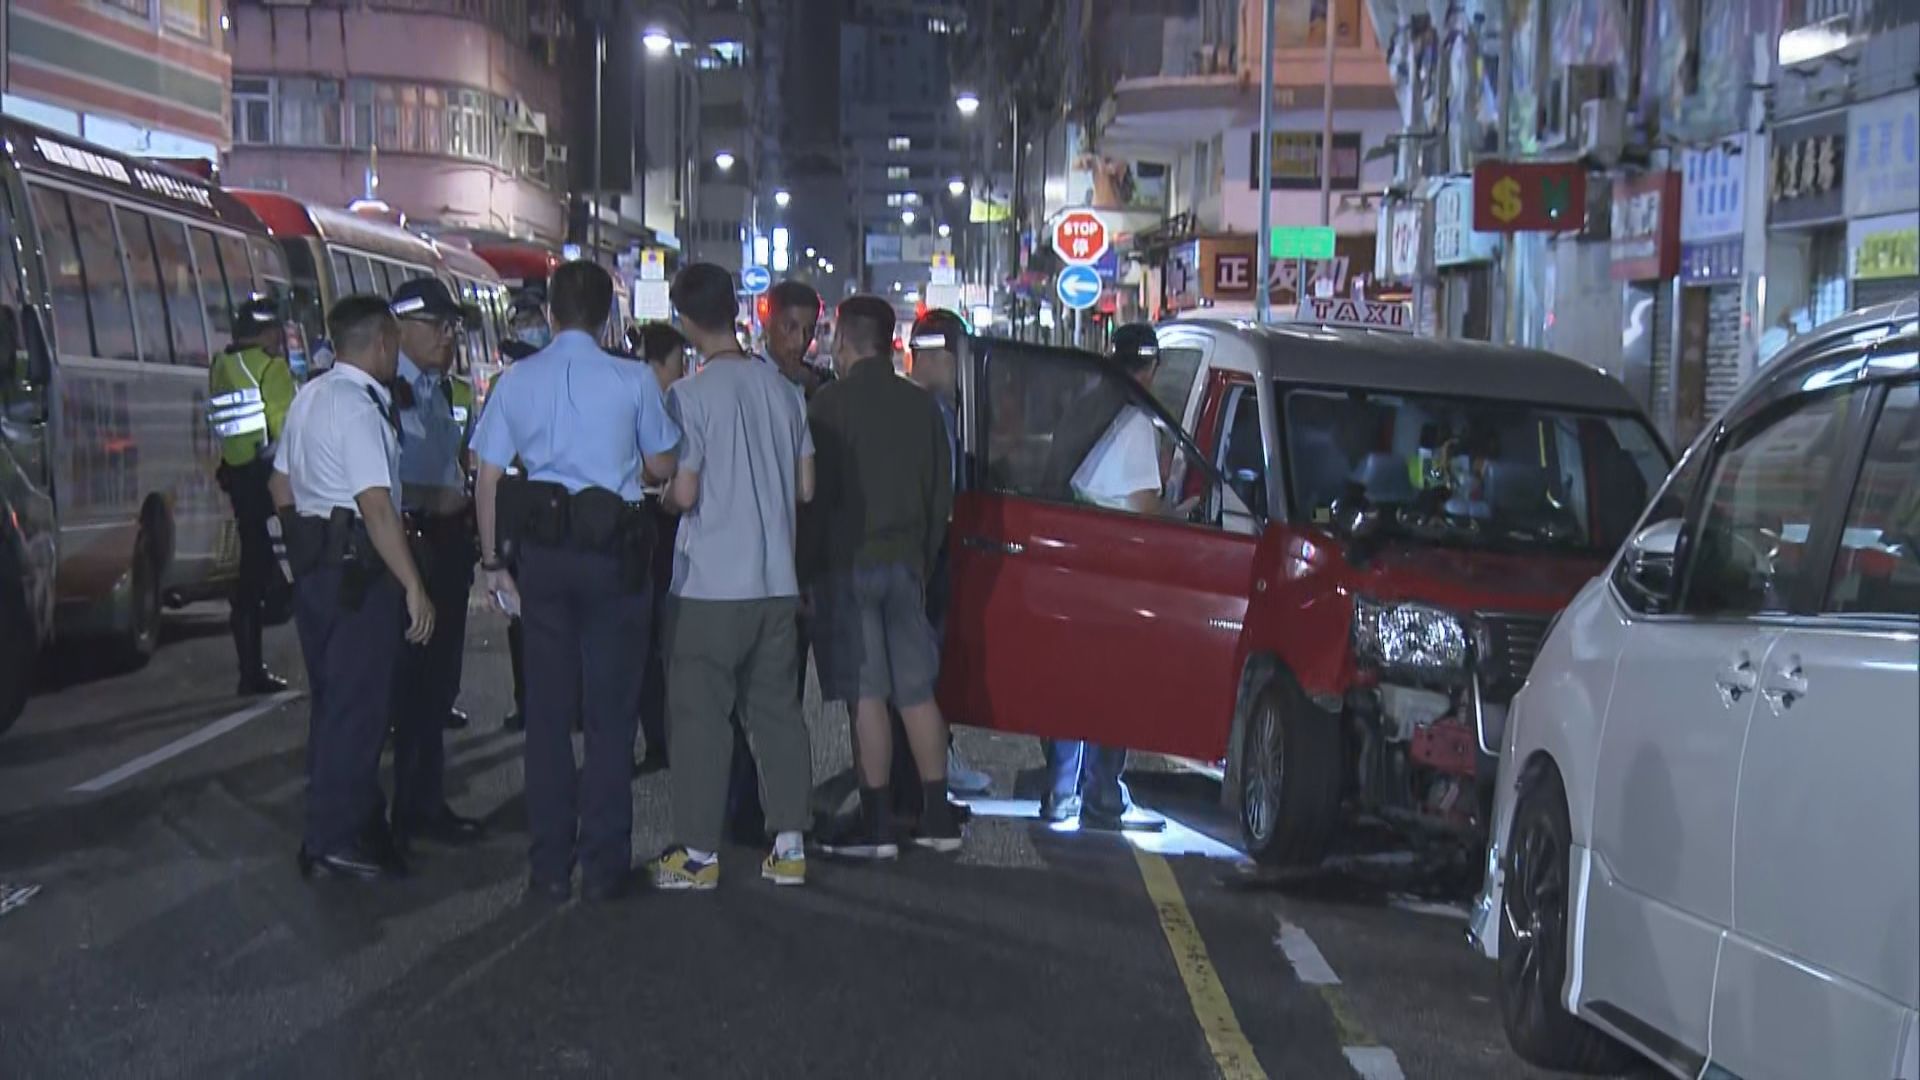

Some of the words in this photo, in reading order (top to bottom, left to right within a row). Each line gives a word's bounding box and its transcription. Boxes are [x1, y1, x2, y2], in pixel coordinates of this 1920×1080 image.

[1491, 175, 1522, 222] $
[1063, 221, 1098, 237] STOP
[1313, 299, 1404, 328] TAXI
